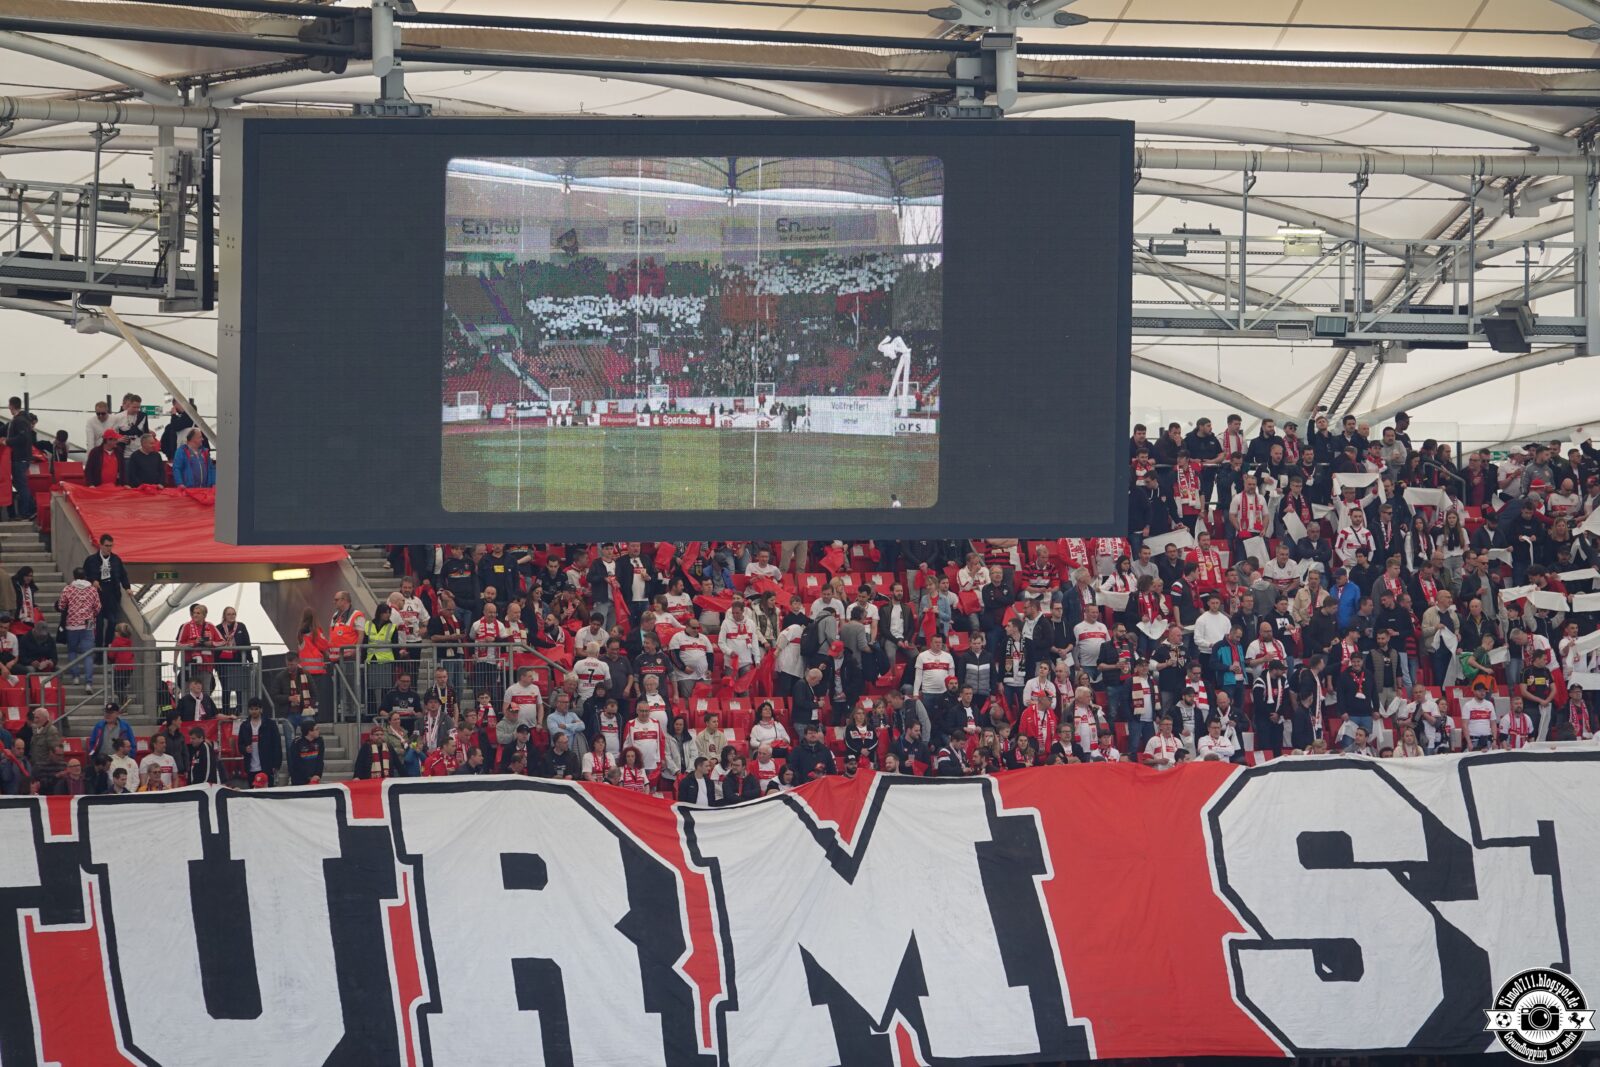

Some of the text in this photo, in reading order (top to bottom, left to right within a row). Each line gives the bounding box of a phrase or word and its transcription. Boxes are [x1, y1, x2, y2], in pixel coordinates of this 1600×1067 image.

[662, 415, 702, 425] Sparkasse
[720, 420, 733, 428] LBS
[757, 420, 770, 428] LBS
[587, 668, 595, 683] 7
